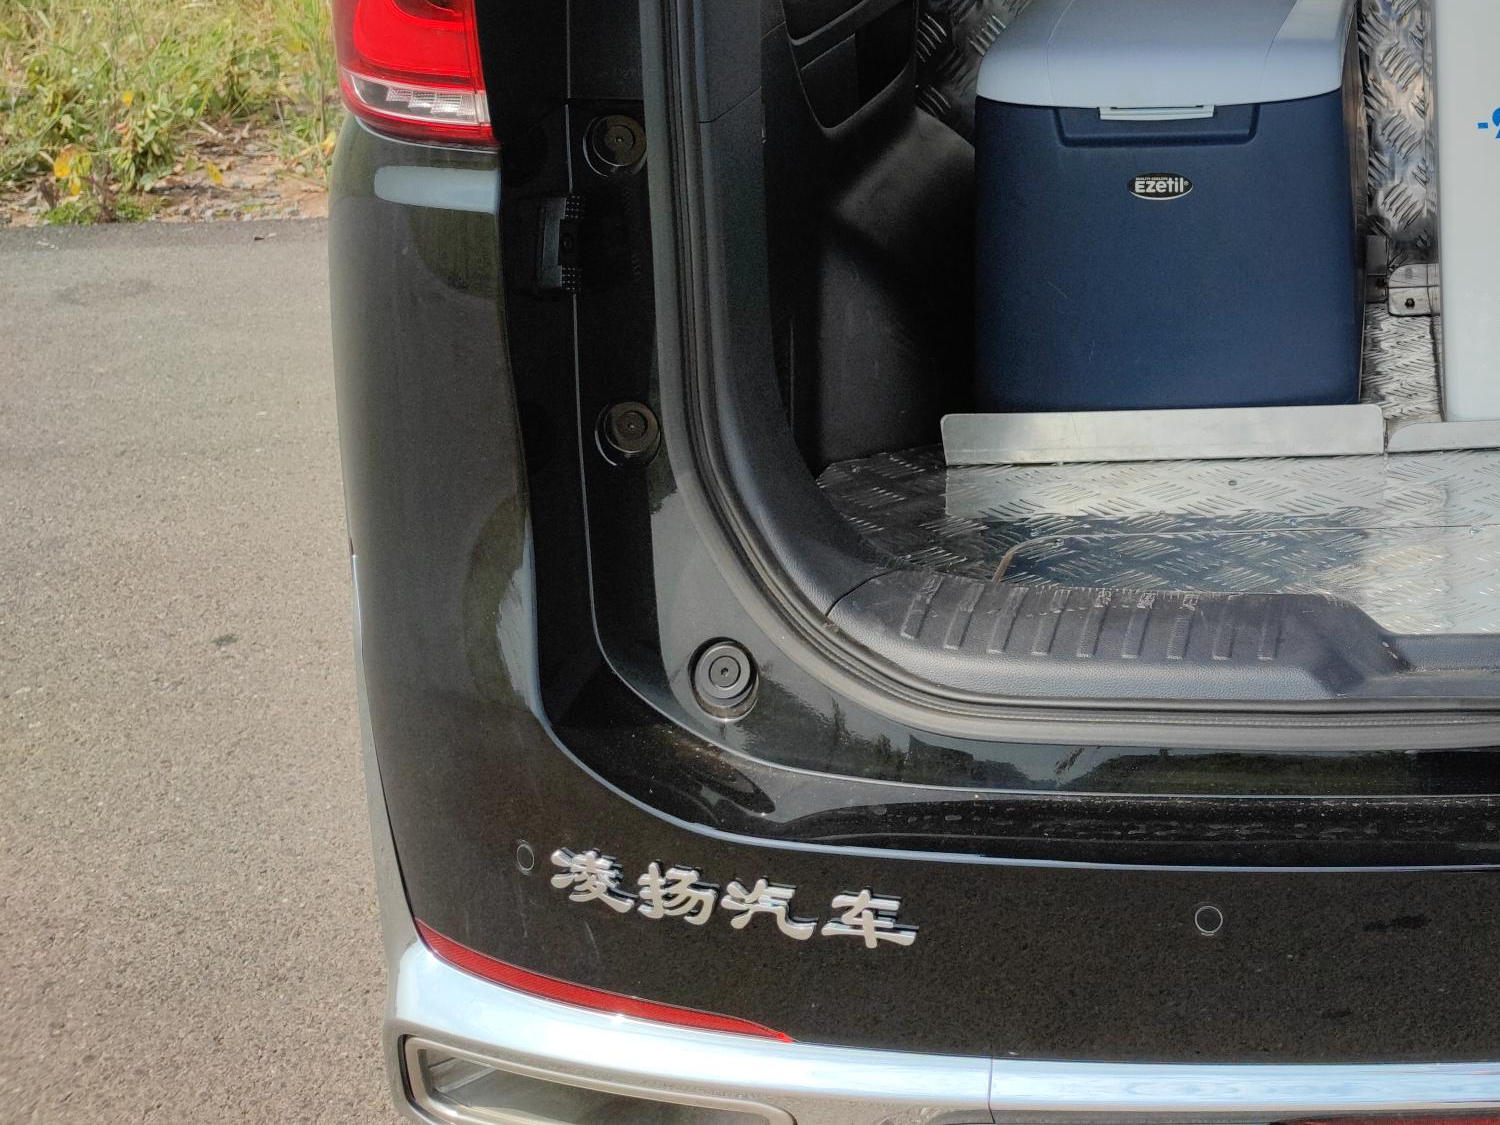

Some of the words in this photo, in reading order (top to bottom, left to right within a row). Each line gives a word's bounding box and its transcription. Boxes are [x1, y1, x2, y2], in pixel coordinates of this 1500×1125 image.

[1135, 177, 1184, 193] Ezetil
[550, 847, 920, 949] 凌扬汽车
